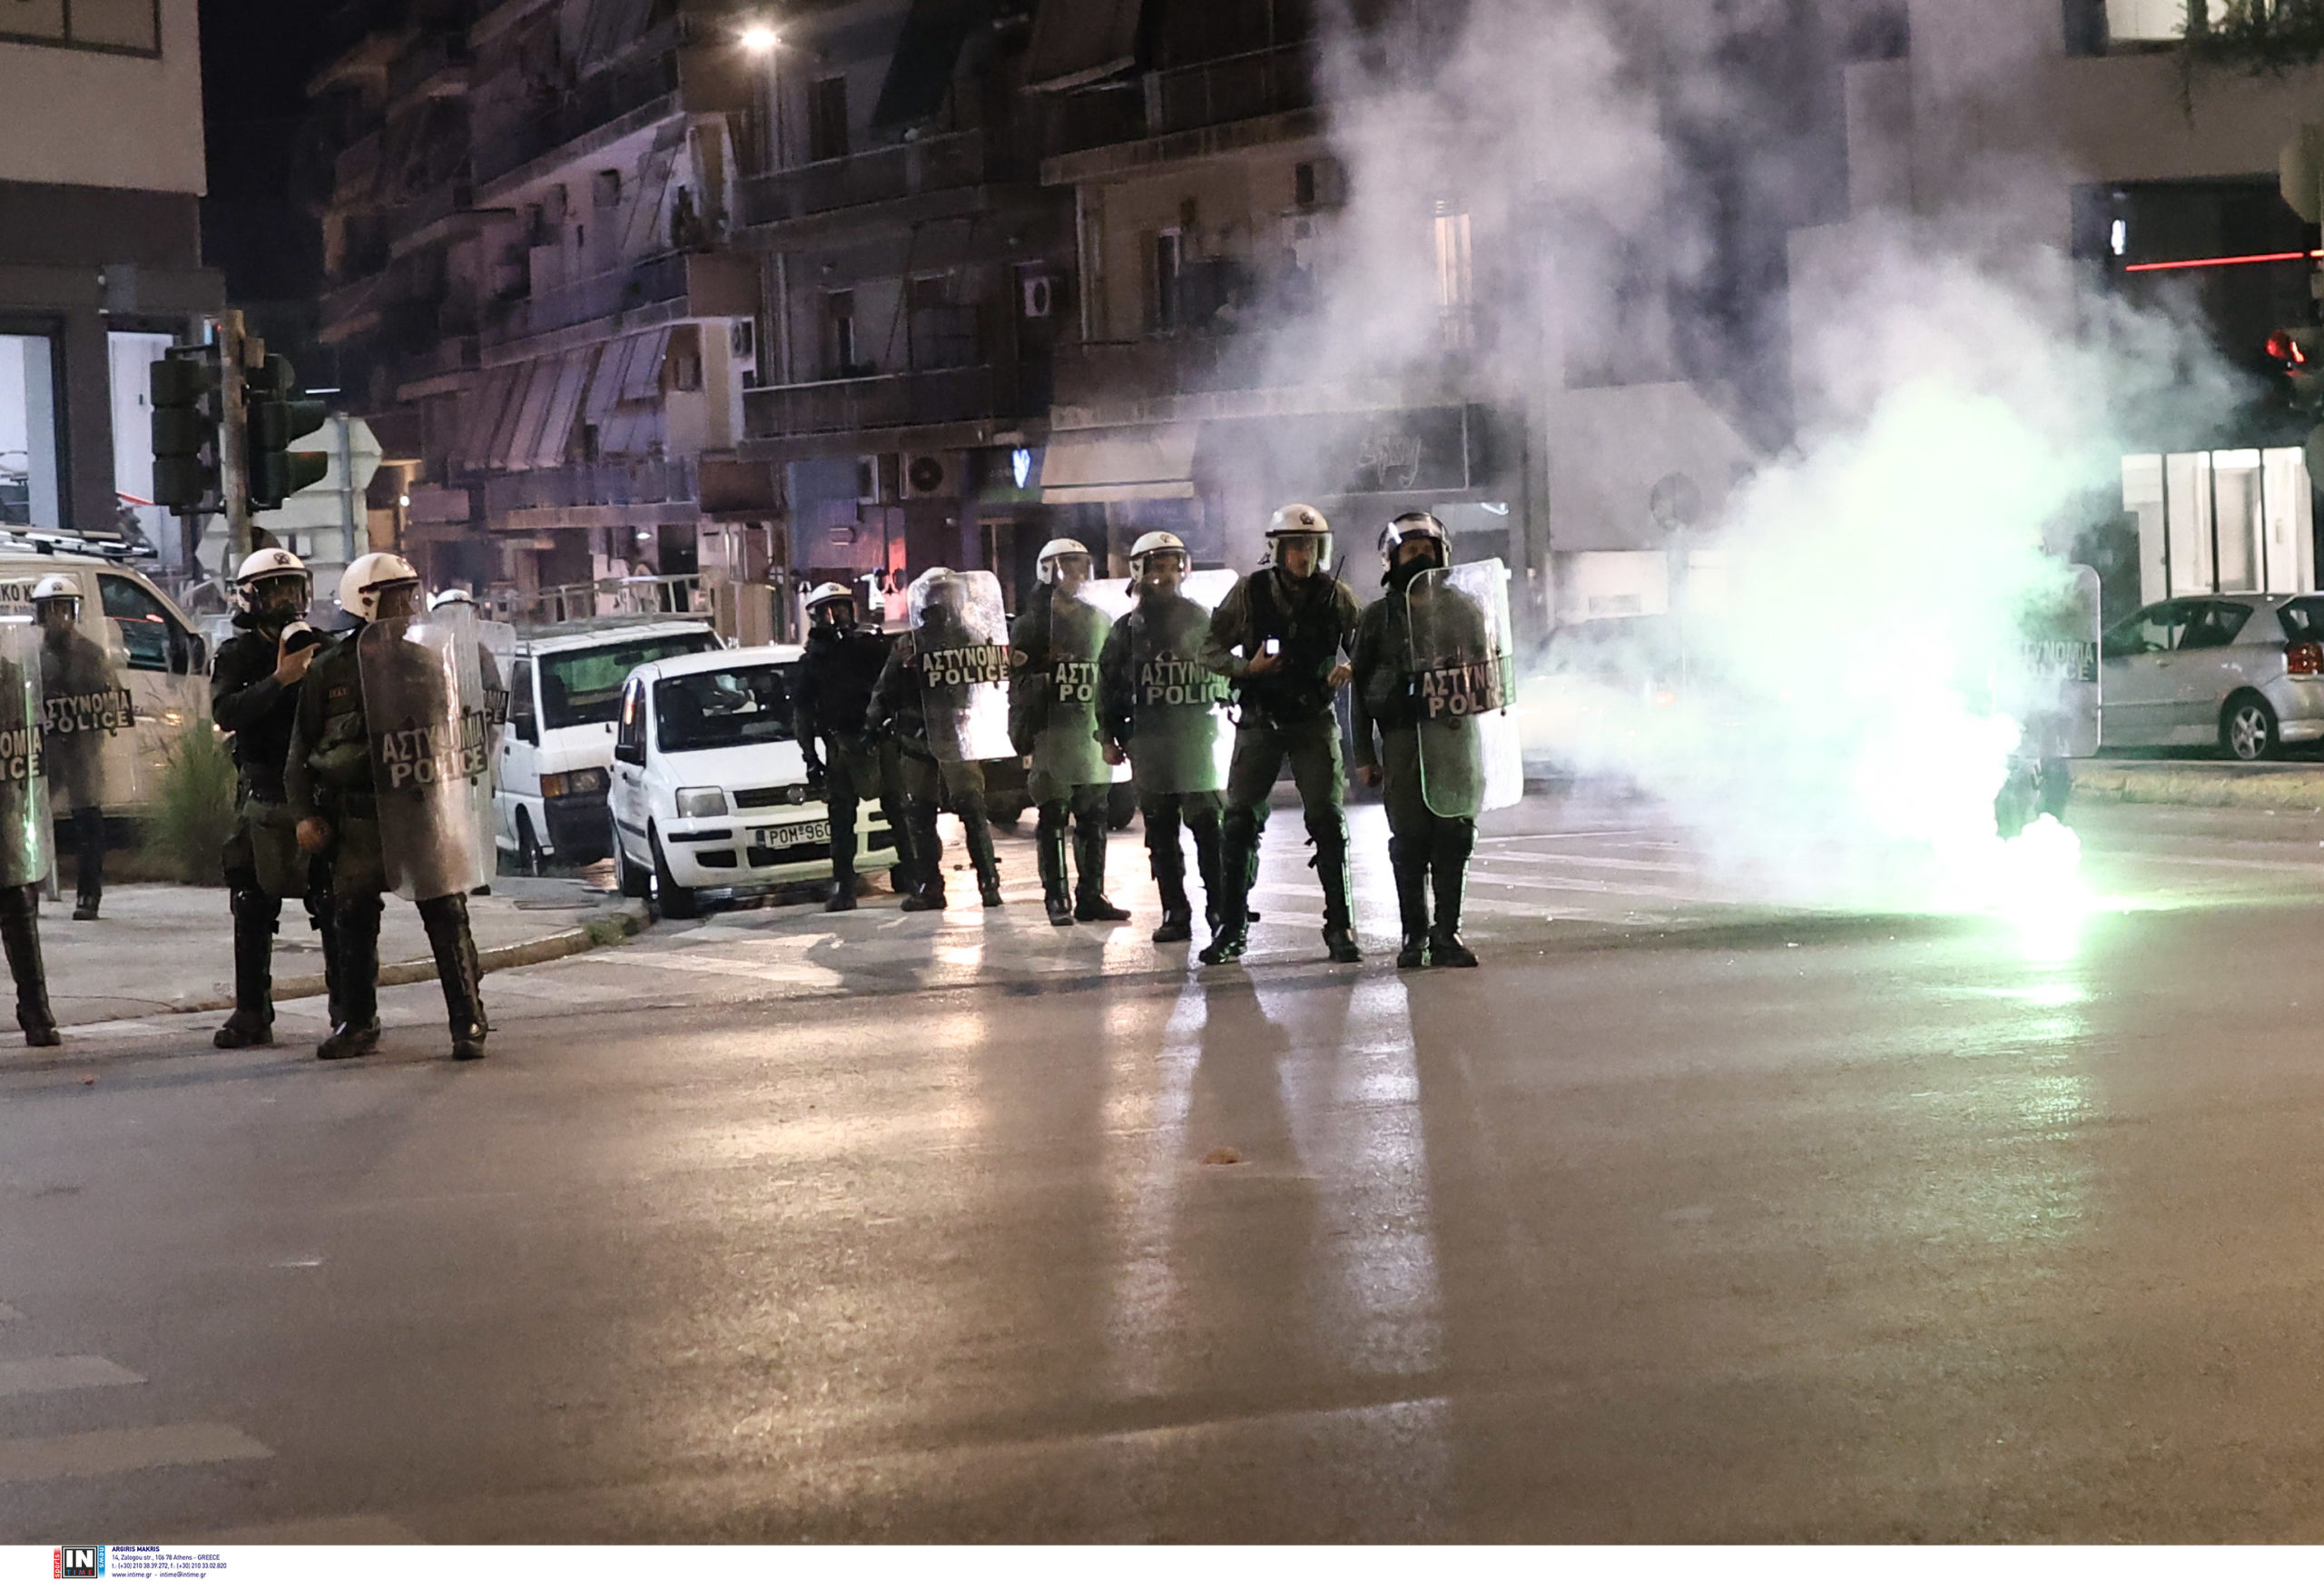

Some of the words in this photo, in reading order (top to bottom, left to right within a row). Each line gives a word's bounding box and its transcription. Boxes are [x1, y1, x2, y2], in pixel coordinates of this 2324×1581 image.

[923, 645, 1010, 672] ΑΣΤΥΝΟΜΙΑ
[929, 665, 1009, 687] POLICE
[1059, 684, 1093, 702] PO
[43, 711, 129, 736] POLICE
